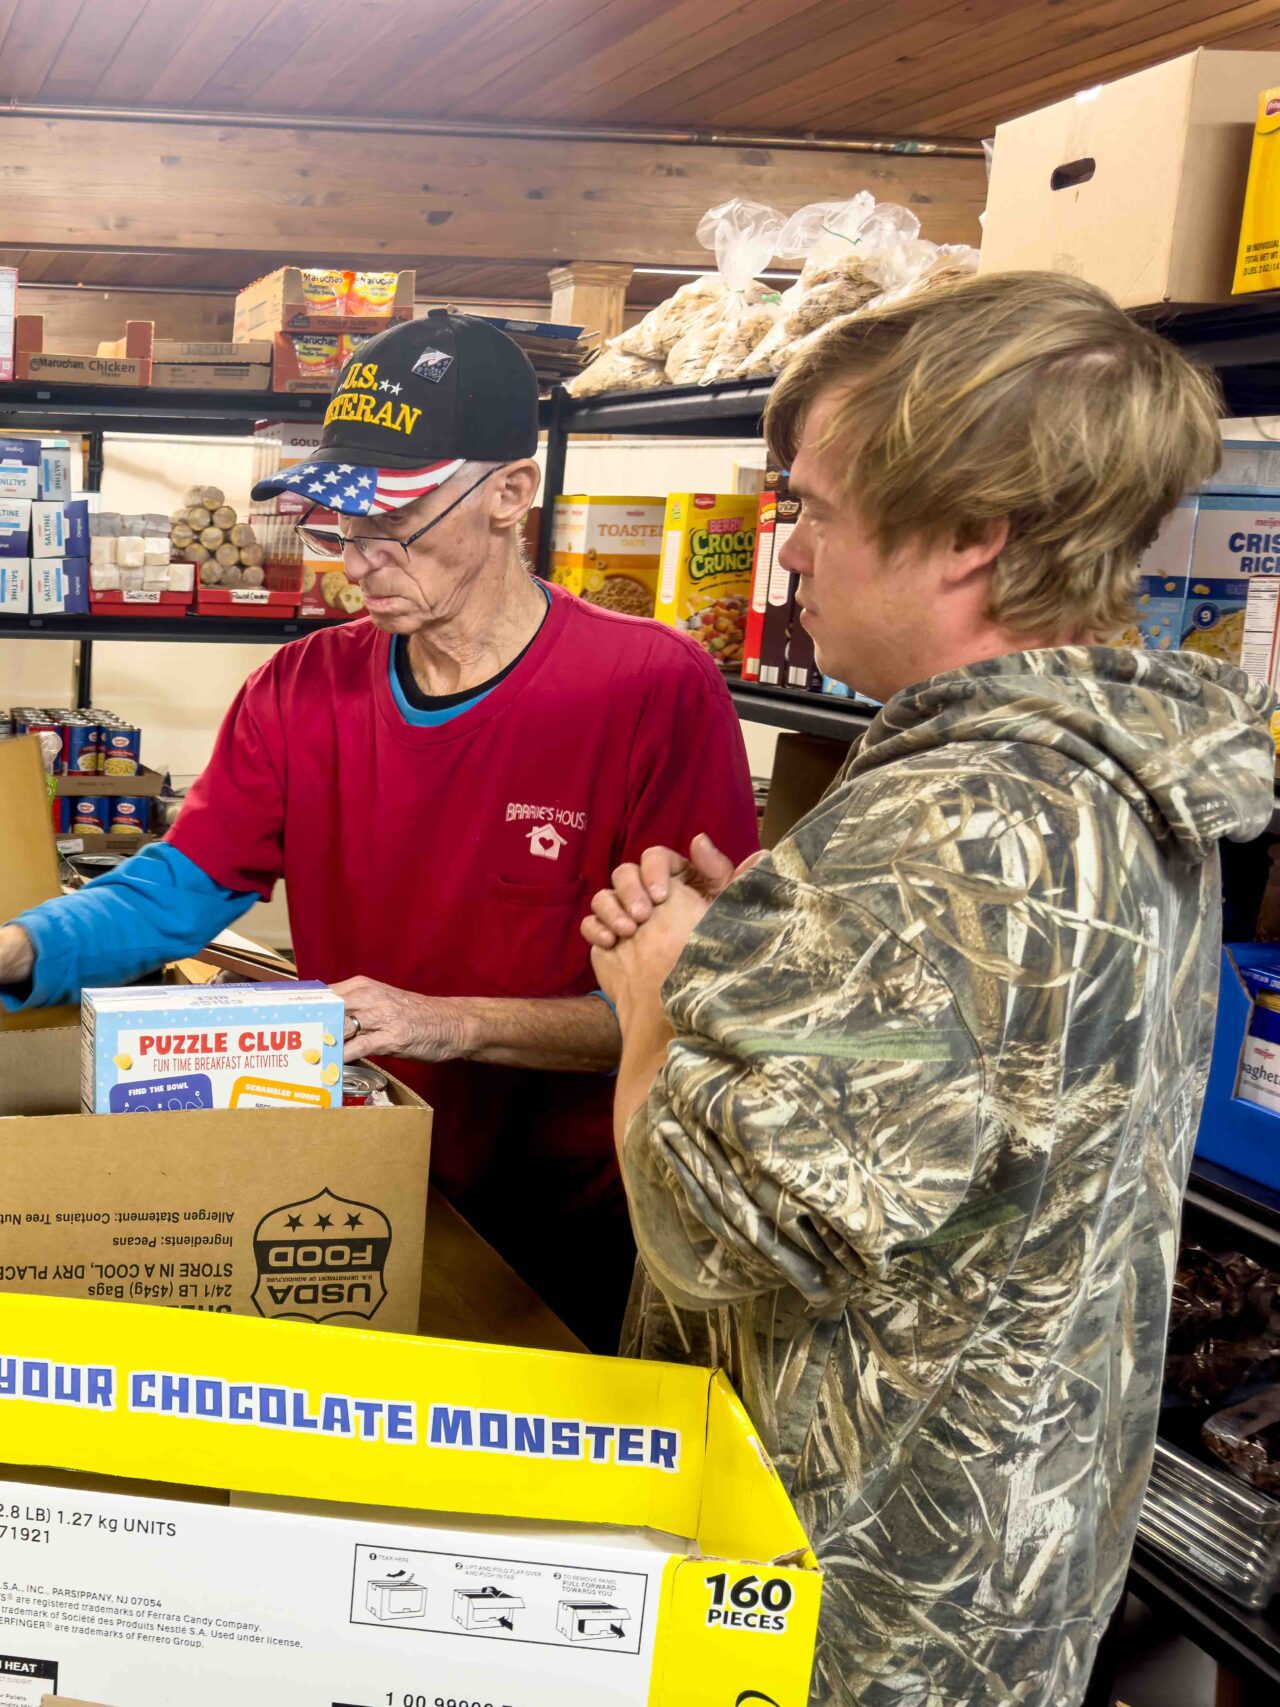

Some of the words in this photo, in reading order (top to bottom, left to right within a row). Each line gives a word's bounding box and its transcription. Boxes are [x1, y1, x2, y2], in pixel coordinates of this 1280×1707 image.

[40, 357, 85, 369] Maruchan
[88, 361, 135, 373] Chicken
[322, 393, 422, 435] TERAN
[692, 529, 755, 556] CROCO
[10, 570, 18, 601] SALTINE
[505, 802, 555, 821] BARRIE'S
[555, 808, 587, 830] HOUS
[139, 1031, 228, 1056] PUZZLE
[238, 1030, 302, 1051] CLUB
[153, 1057, 170, 1072] FUN
[172, 1056, 192, 1072] TIME
[194, 1054, 243, 1071] BREAKFAST
[244, 1053, 289, 1070] ACTIVITIES
[128, 1086, 148, 1097] FIND
[149, 1085, 165, 1095] THE
[166, 1081, 189, 1093] BOWL
[245, 1083, 291, 1098] SCRAMBLED
[293, 1091, 321, 1101] WORDS
[25, 1214, 51, 1225] Tree
[55, 1213, 110, 1224] Contains
[114, 1212, 180, 1223] Statement:
[183, 1211, 234, 1223] Allergen
[112, 1236, 156, 1248] Pecans
[161, 1234, 233, 1247] Ingredients:
[268, 1245, 373, 1267] FOOD
[52, 1266, 85, 1280] DRY
[90, 1263, 140, 1279] COOL,
[144, 1264, 156, 1278] A
[160, 1264, 174, 1278] IN
[179, 1264, 233, 1277] STORE
[87, 1285, 124, 1298] Bags
[130, 1282, 174, 1298] (454g)
[179, 1284, 198, 1297] LB
[204, 1284, 232, 1297] 24/1
[266, 1283, 372, 1305] USDA
[131, 1374, 413, 1440] CHOCOLATE
[430, 1406, 677, 1469] MONSTER
[25, 1506, 51, 1524] LB)
[56, 1509, 93, 1527] 1.27
[98, 1514, 119, 1533] kg
[124, 1518, 177, 1537] UNITS
[52, 1587, 114, 1602] PARSIPPANY,
[116, 1595, 129, 1605] NJ
[130, 1597, 162, 1608] 07054
[706, 1573, 792, 1612] 160
[15, 1596, 31, 1605] are
[32, 1597, 80, 1611] registered
[81, 1603, 134, 1617] trademarks
[135, 1609, 146, 1618] of
[147, 1610, 181, 1622] Ferrara
[183, 1614, 214, 1627] Candy
[215, 1618, 263, 1632] Company.
[708, 1608, 785, 1631] PIECES
[1, 1605, 49, 1618] trademark
[50, 1611, 60, 1619] of
[61, 1611, 96, 1624] Société
[97, 1617, 114, 1626] des
[116, 1618, 155, 1631] Produits
[156, 1623, 187, 1635] Nestlé
[189, 1627, 208, 1637] S.A.
[210, 1629, 235, 1641] Used
[236, 1634, 265, 1644] under
[54, 1624, 70, 1633] are
[71, 1625, 124, 1639] trademarks
[125, 1631, 136, 1640] of
[137, 1632, 171, 1645] Ferrero
[172, 1636, 205, 1649] Group.
[4, 1660, 38, 1673] HEAT
